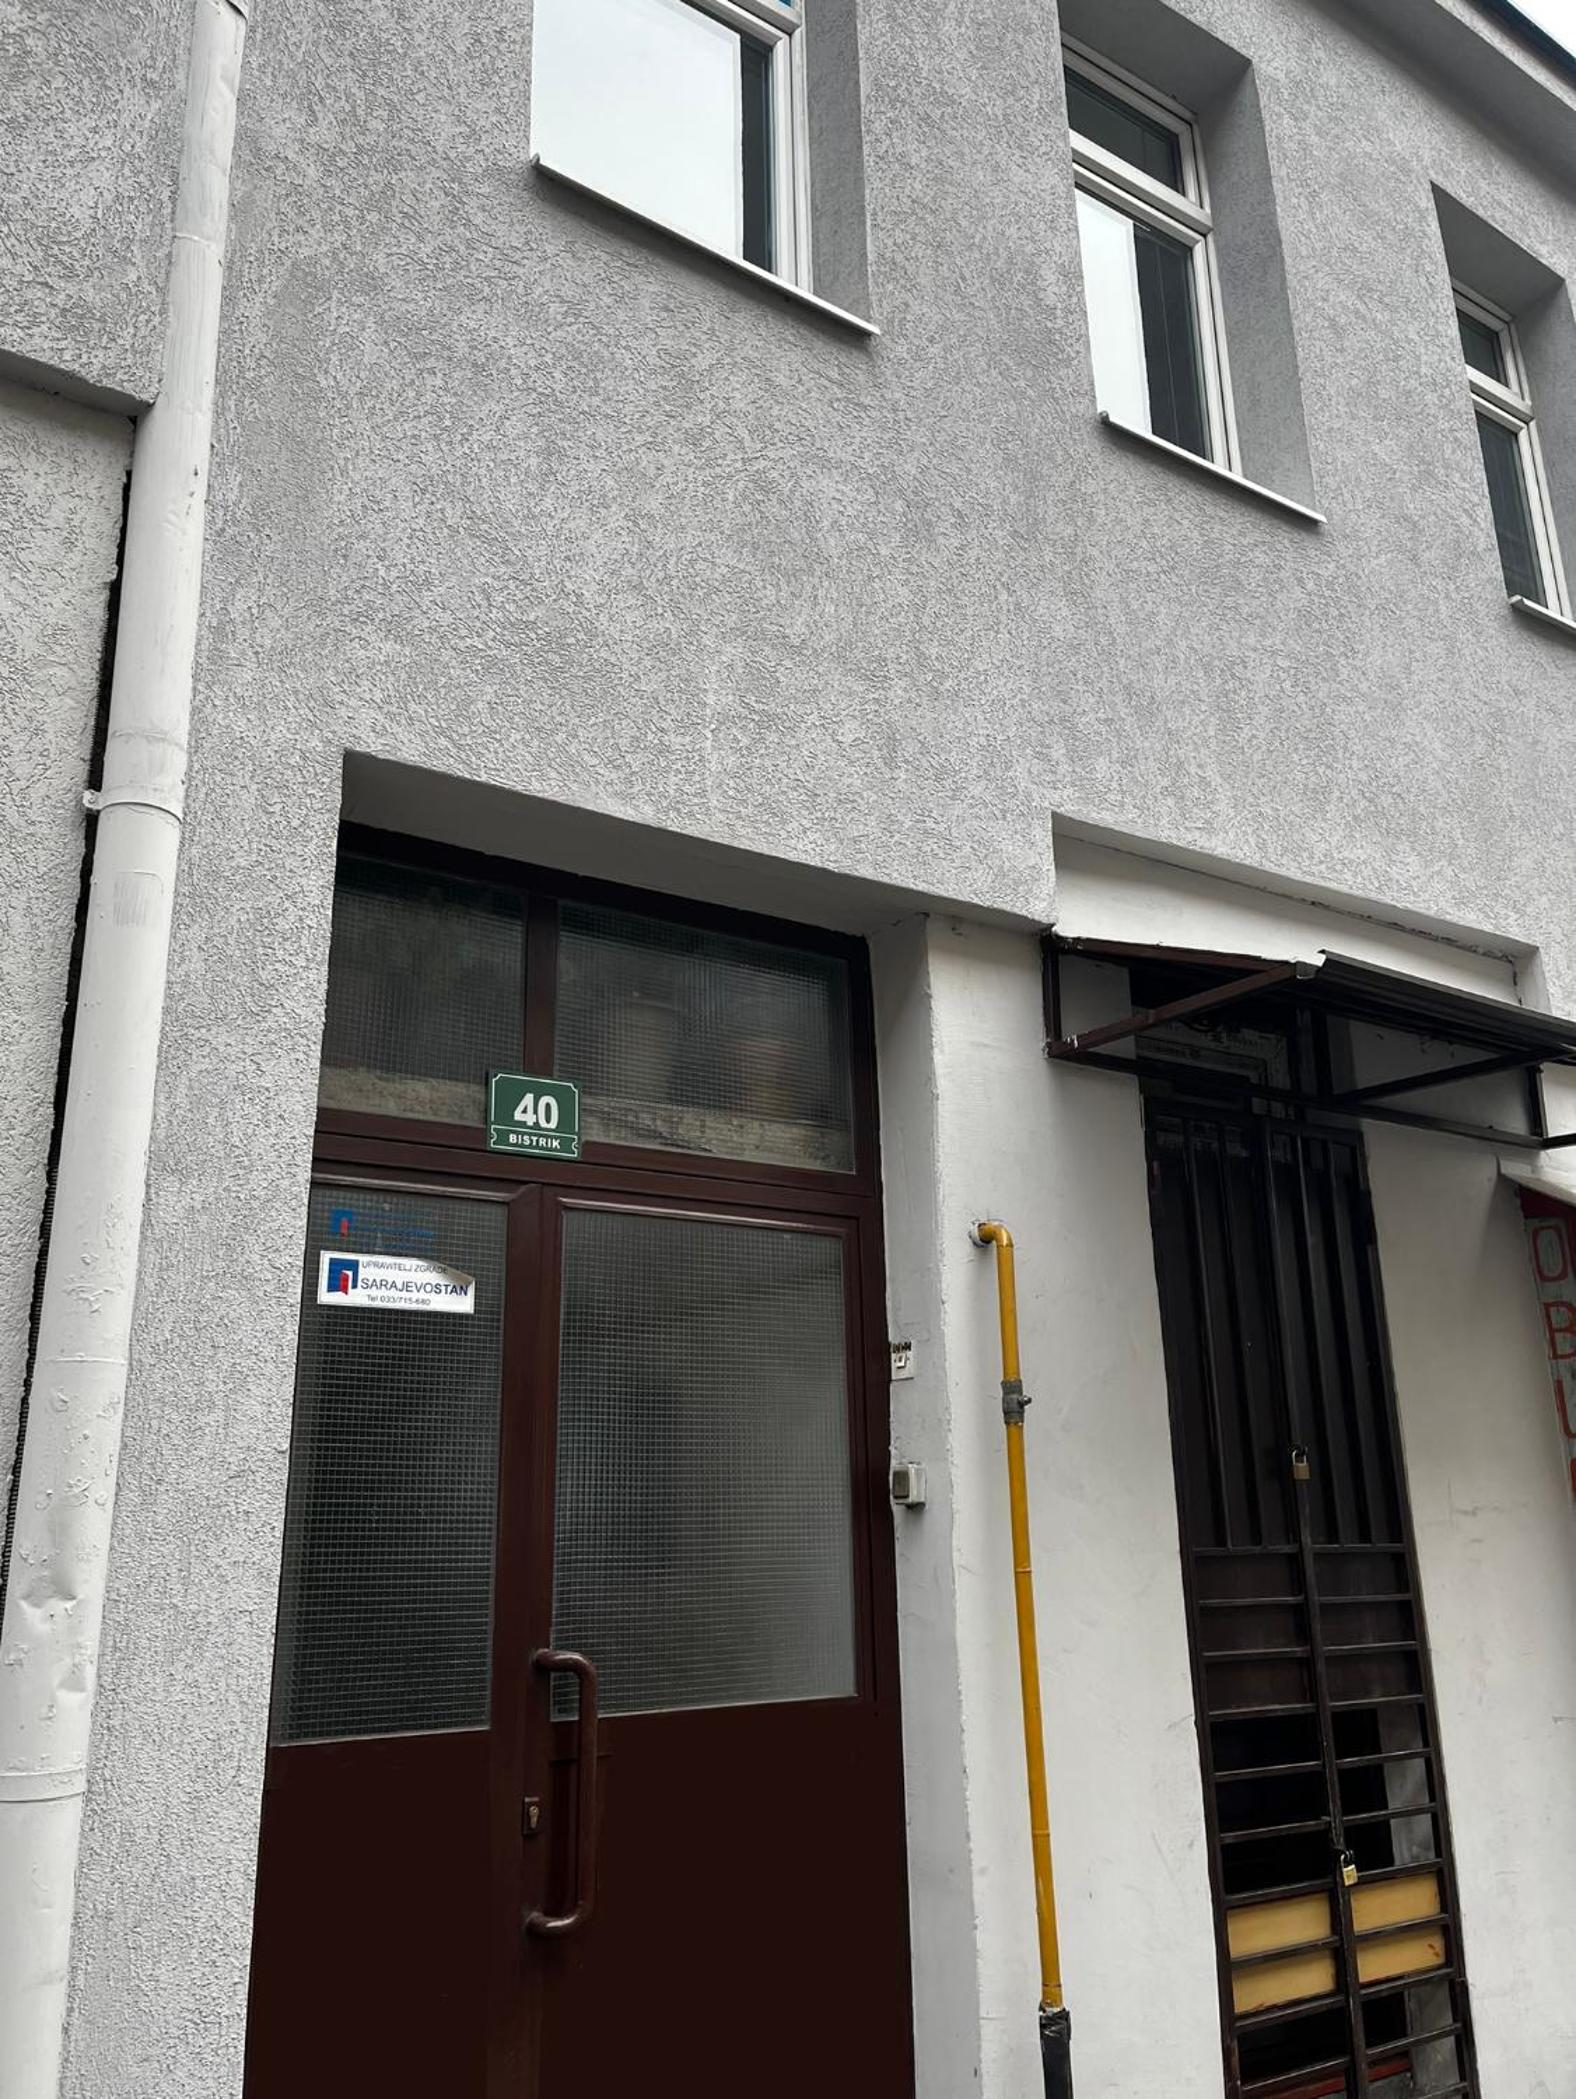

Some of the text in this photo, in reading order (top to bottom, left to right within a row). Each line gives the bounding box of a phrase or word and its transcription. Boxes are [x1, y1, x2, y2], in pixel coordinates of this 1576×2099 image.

[514, 1093, 558, 1129] 40
[509, 1133, 560, 1149] BISTRIK
[361, 1260, 448, 1275] UPRAVITELJ ZGRADE
[360, 1278, 468, 1296] SARAJEVOSTAN
